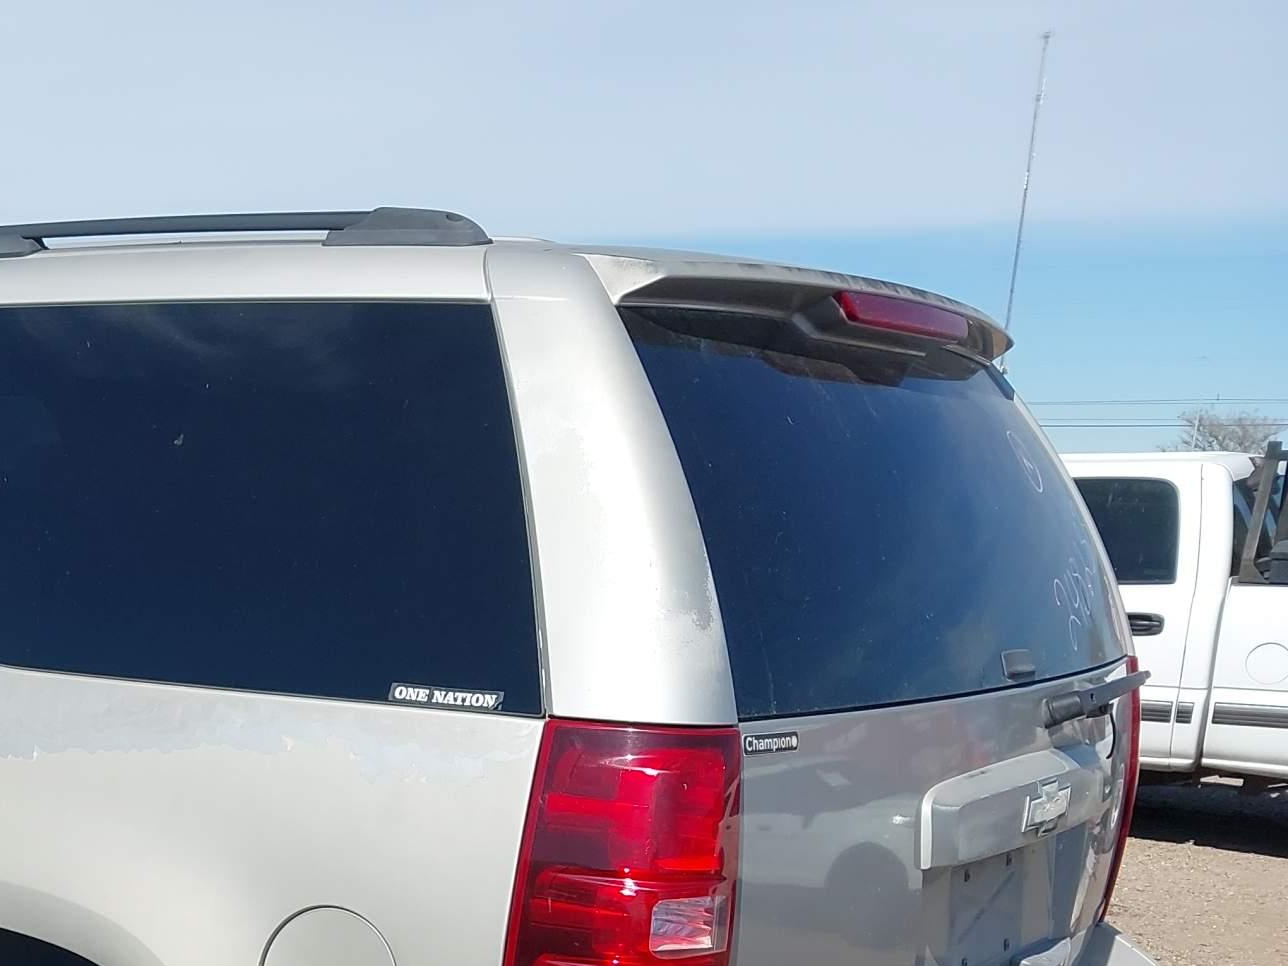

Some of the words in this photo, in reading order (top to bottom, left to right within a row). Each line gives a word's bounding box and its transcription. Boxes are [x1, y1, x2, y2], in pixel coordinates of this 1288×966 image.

[394, 686, 429, 702] ONE
[432, 690, 497, 708] NATION
[745, 736, 792, 752] Champion
